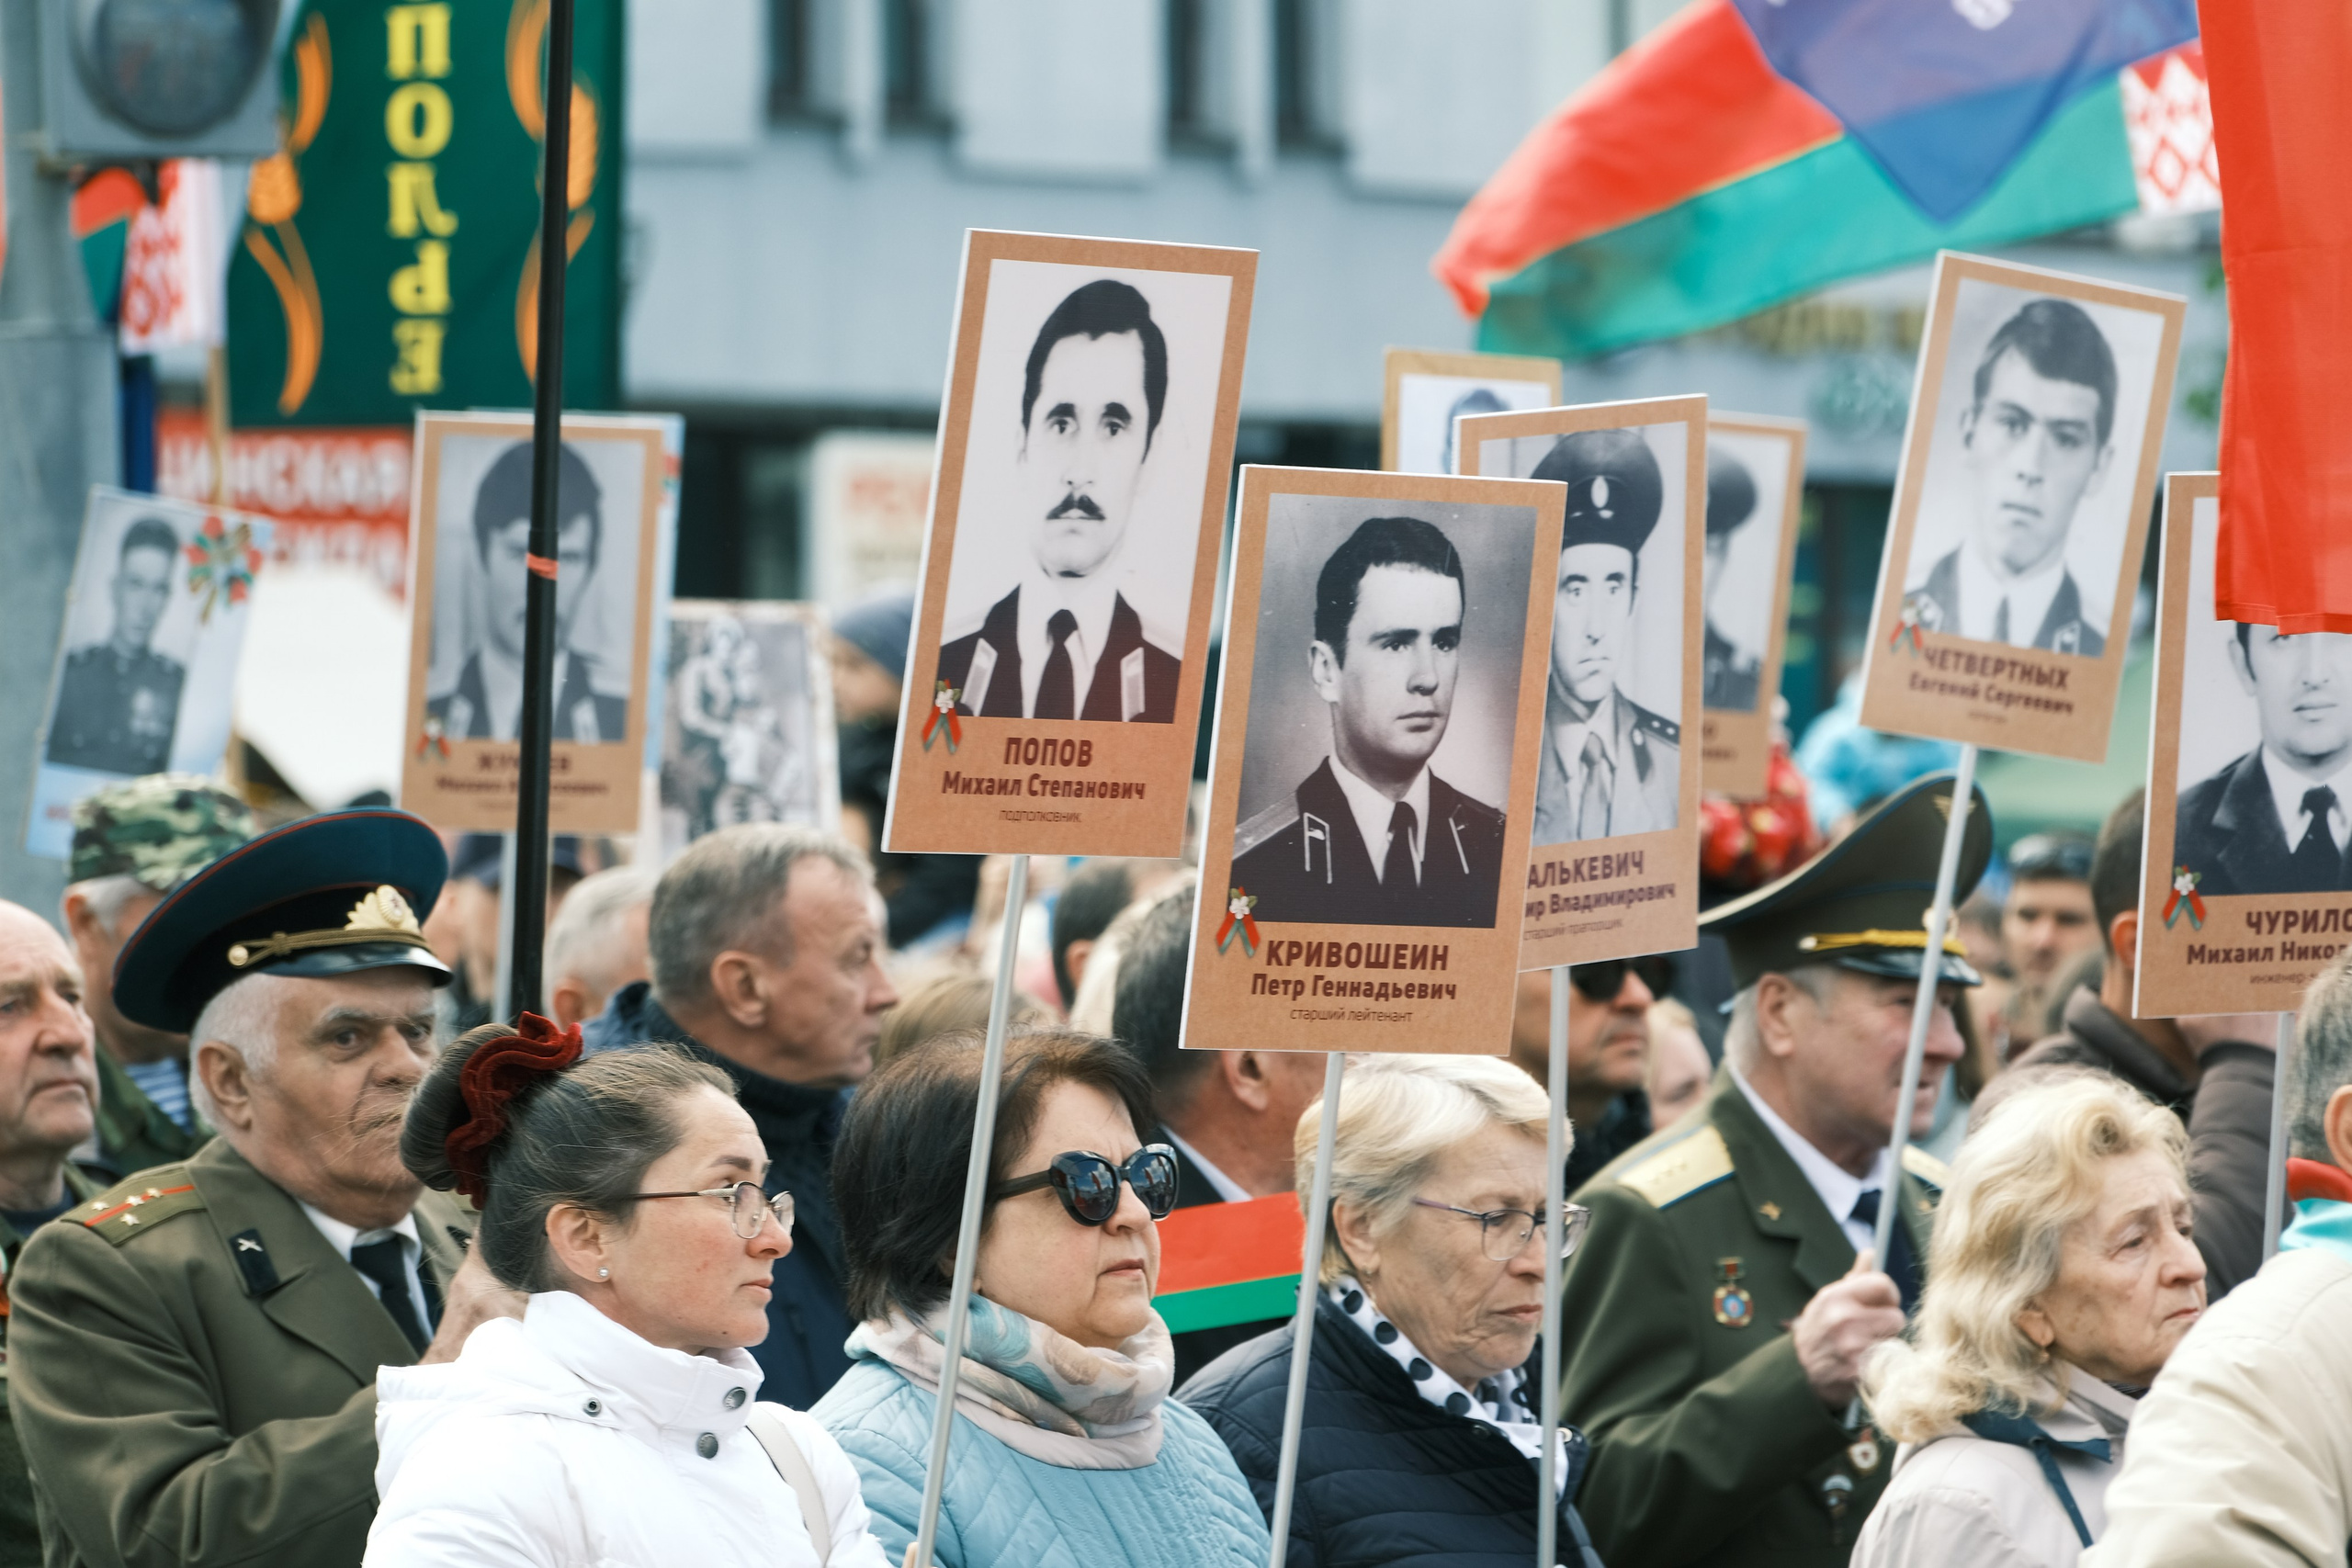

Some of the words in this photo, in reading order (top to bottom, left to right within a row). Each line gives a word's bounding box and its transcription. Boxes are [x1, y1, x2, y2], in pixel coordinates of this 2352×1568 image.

[1924, 648, 2071, 691] ЧЕТВЕРТНЫХ
[1908, 671, 1981, 700] Евгений
[1984, 684, 2075, 716] Сергеевич
[1003, 737, 1094, 768] ПОПОВ
[942, 771, 1023, 796] Михаил
[1027, 773, 1147, 800] Степанович
[1527, 851, 1645, 889] АЛЬКЕВИЧ
[1549, 883, 1677, 914] Владимирович
[1266, 940, 1450, 971] КРИВОШЕИН
[2188, 944, 2274, 965] Михаил
[1250, 973, 1306, 1001] Петр
[1311, 974, 1457, 1002] Геннадьевич
[1290, 1007, 1345, 1024] старший
[1347, 1008, 1413, 1023] лейтенант
